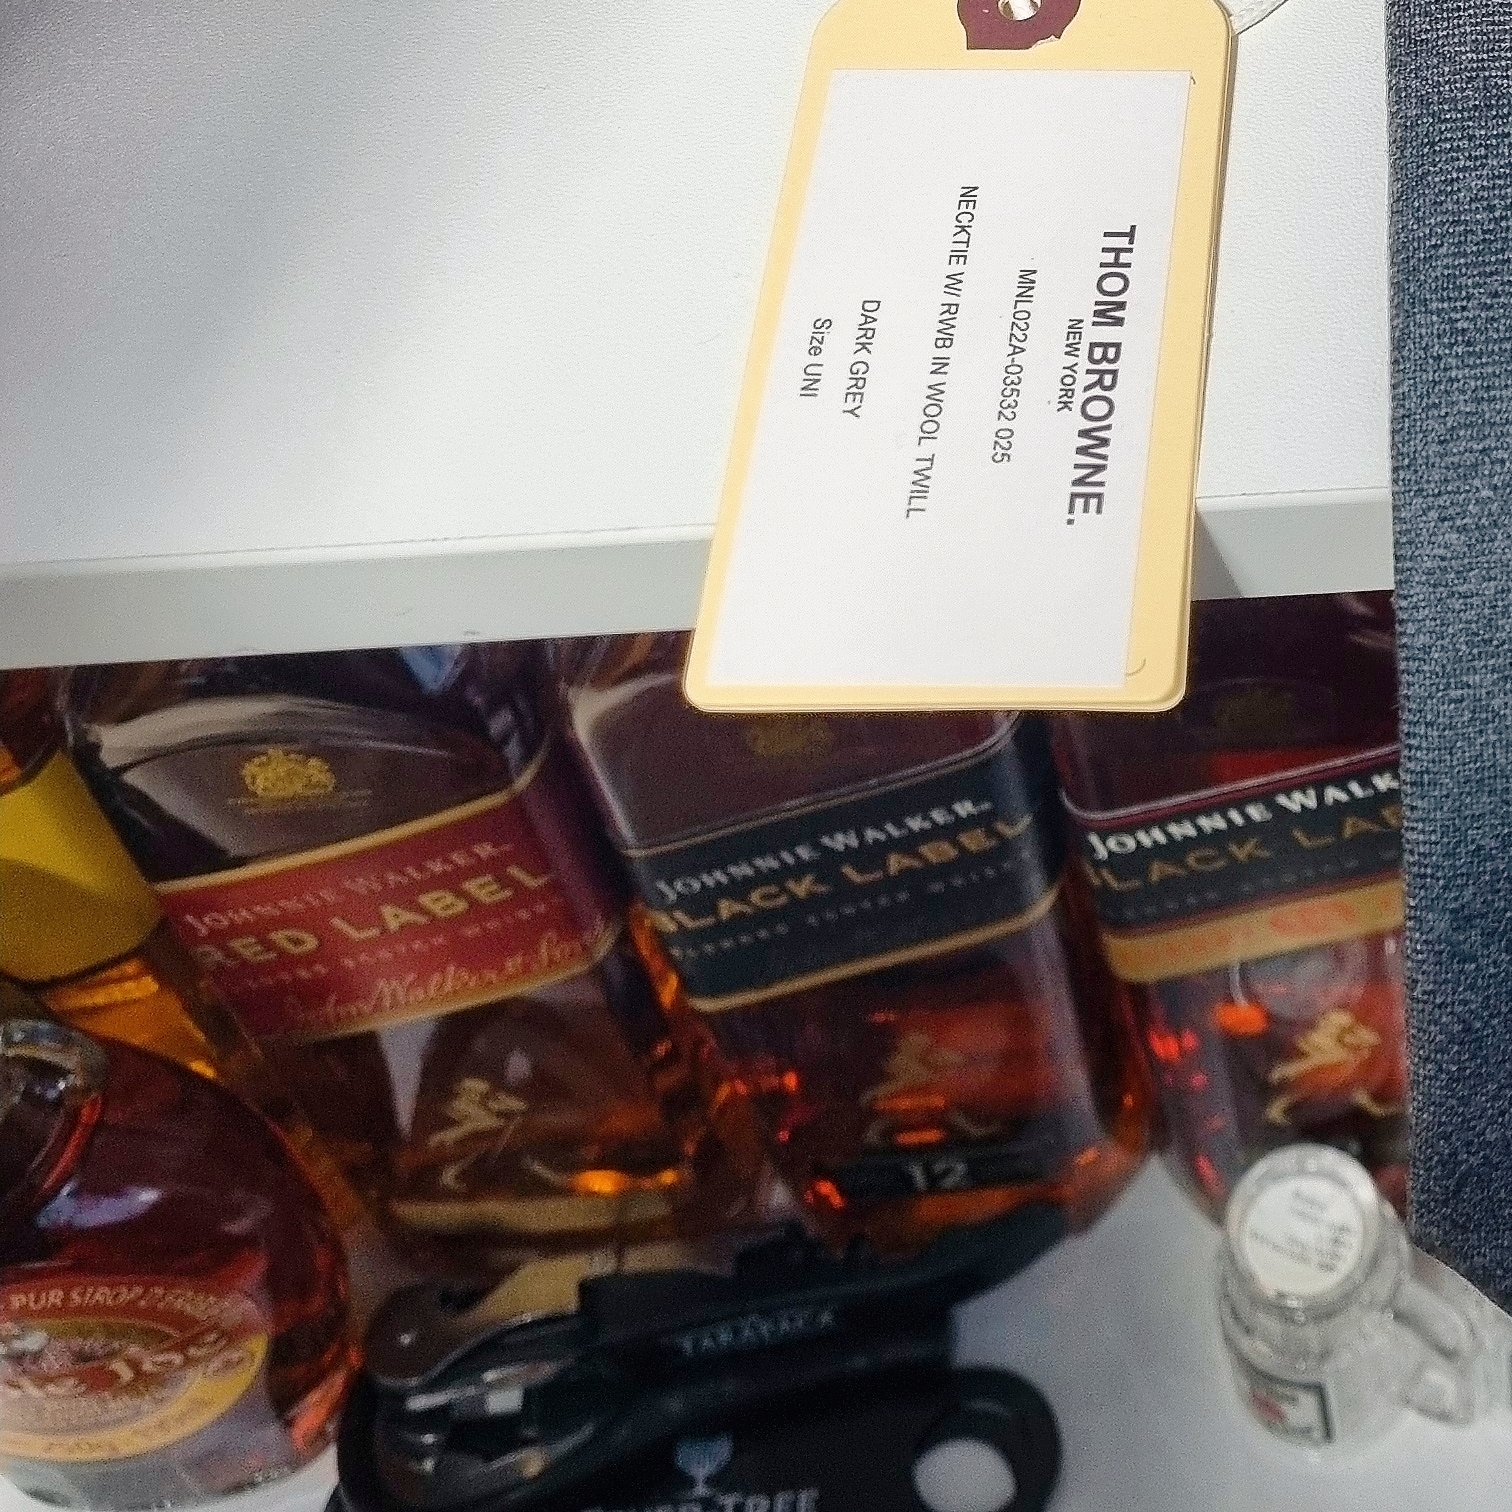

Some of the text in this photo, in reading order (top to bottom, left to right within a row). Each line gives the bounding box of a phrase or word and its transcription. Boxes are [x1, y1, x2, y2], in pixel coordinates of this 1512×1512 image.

[799, 317, 832, 398] Size UNI
[842, 298, 882, 419] DARK GREY
[905, 185, 979, 520] NECKTIE W/ RWB IN WOOL TWILL
[990, 268, 1038, 464] MNL022A-03532 025
[1056, 318, 1084, 413] NEW YORK
[1066, 224, 1137, 525] THOM BROWNE.
[1088, 770, 1402, 861] JOHNNIE WALK
[330, 864, 556, 942] LABEL
[655, 841, 822, 905] JOHNNIE
[906, 1156, 969, 1190] 12
[9, 1288, 65, 1311] PUR
